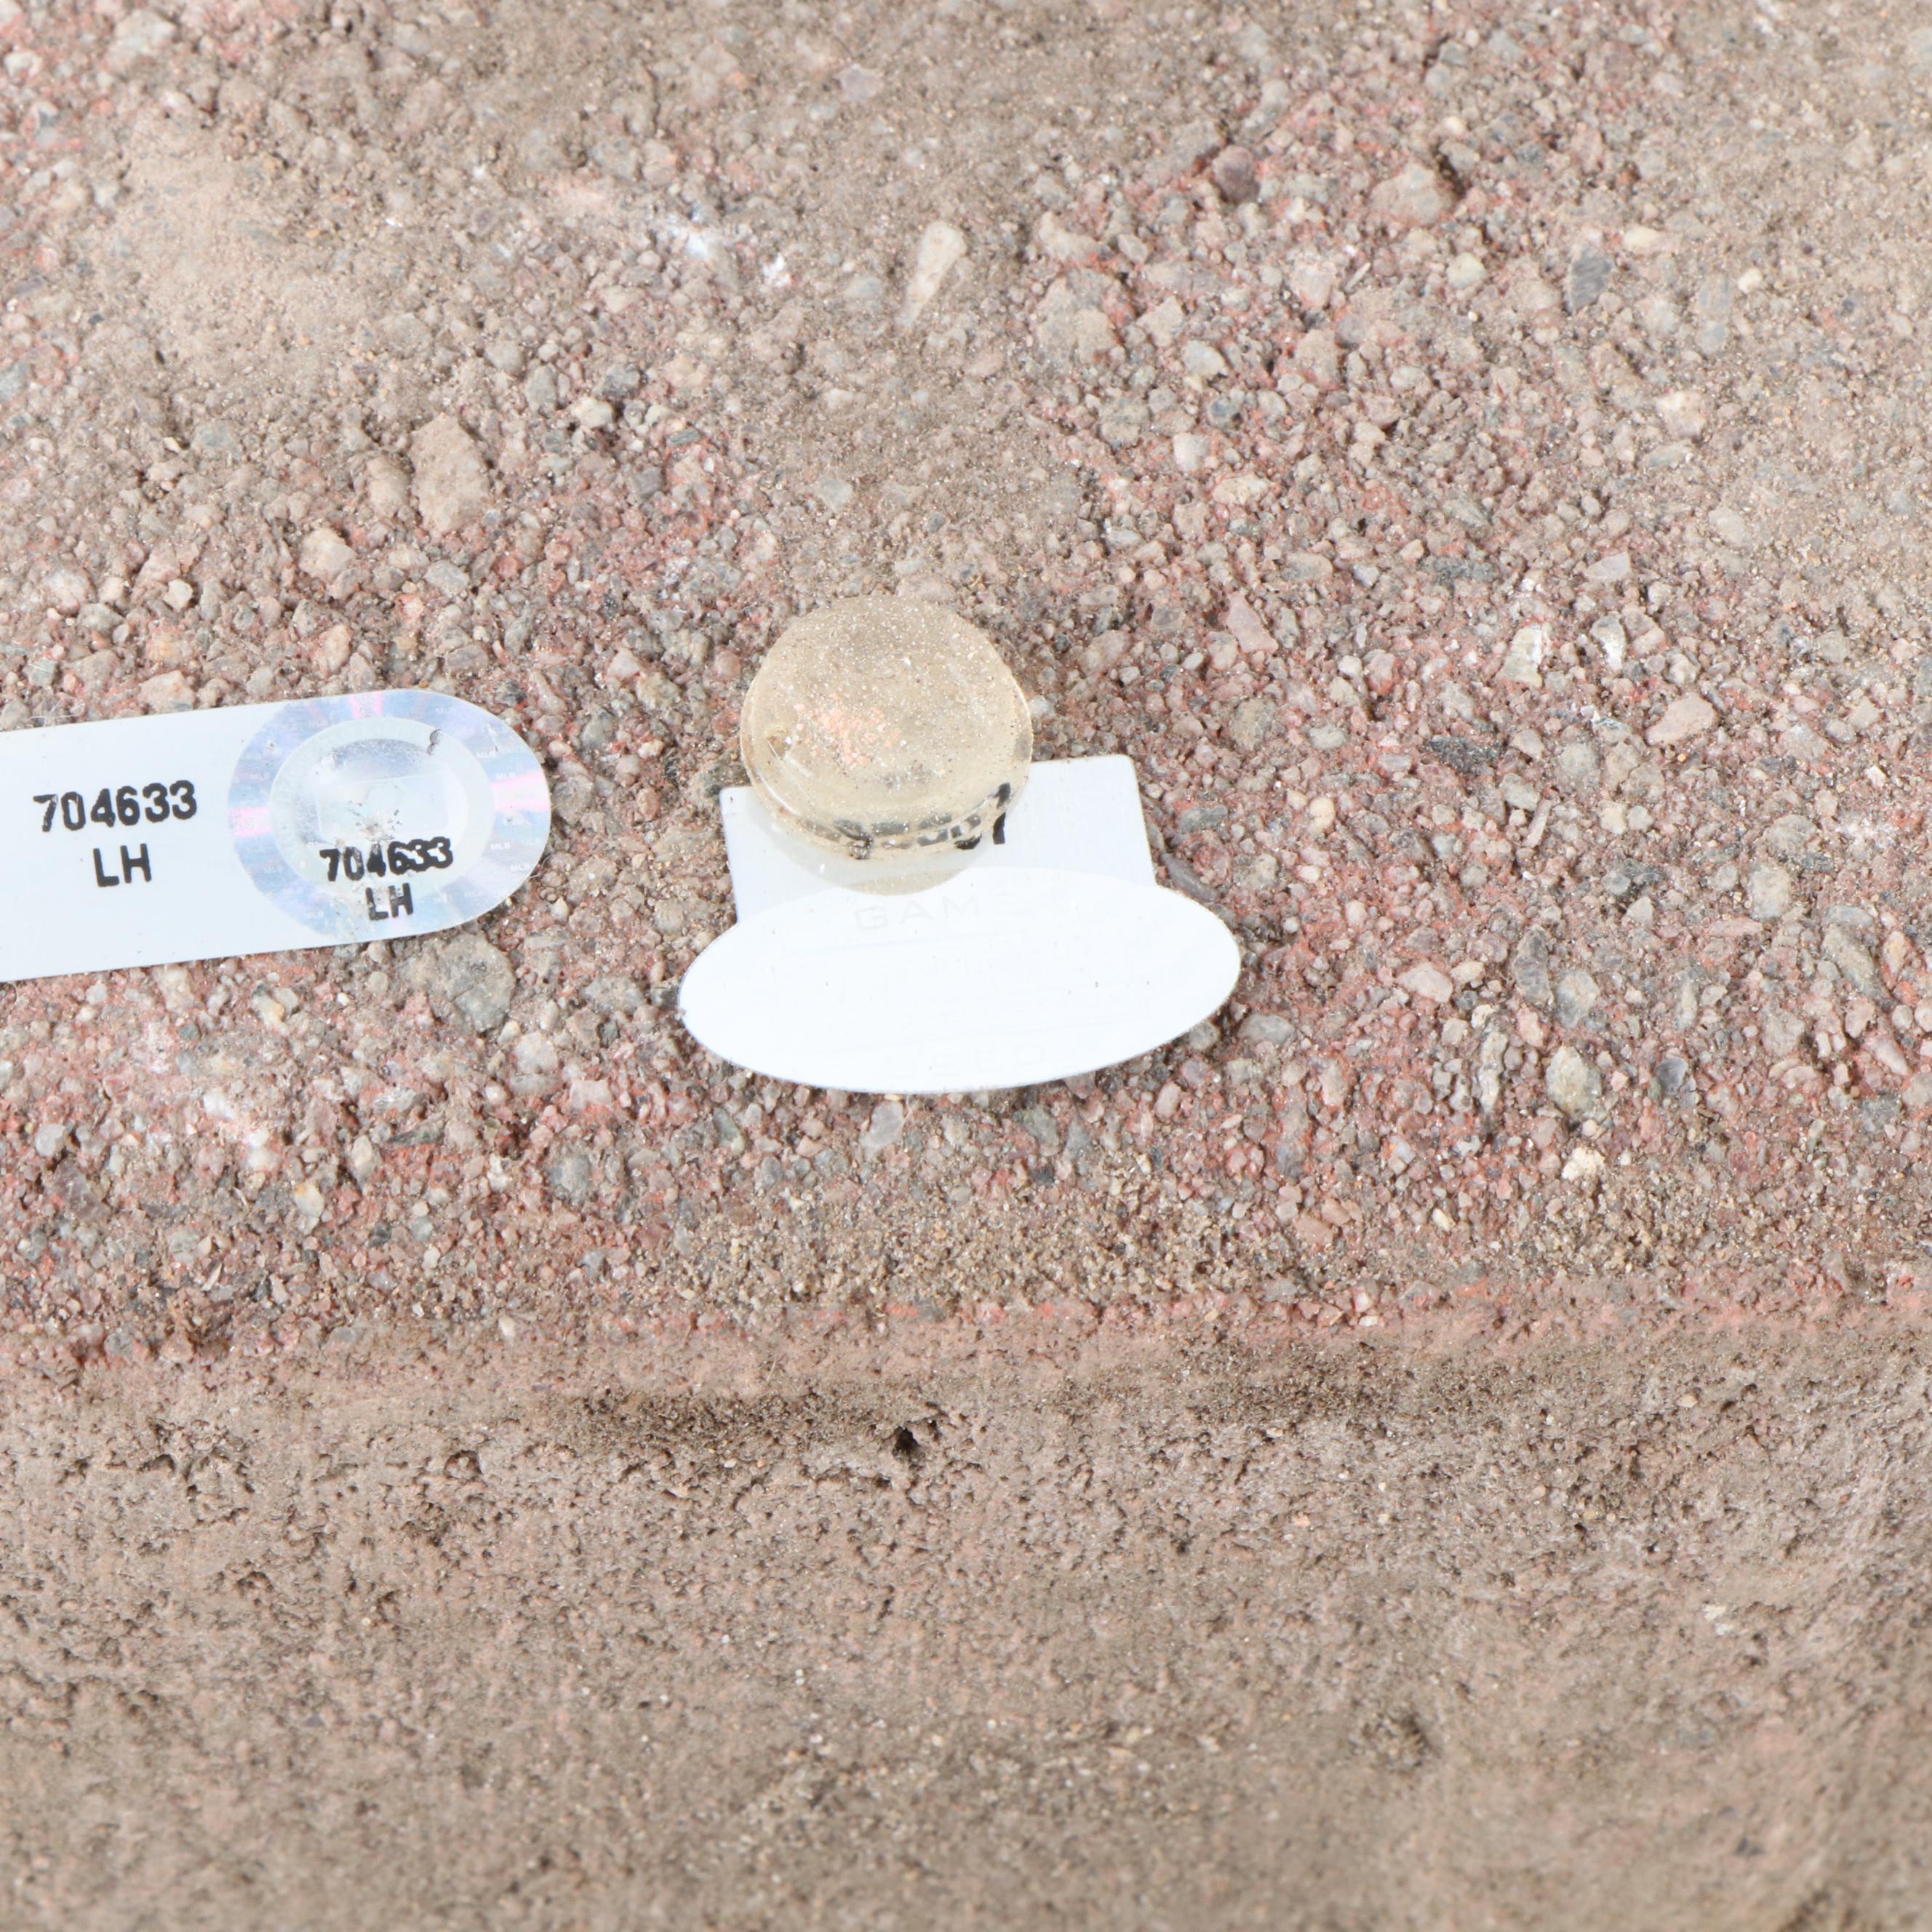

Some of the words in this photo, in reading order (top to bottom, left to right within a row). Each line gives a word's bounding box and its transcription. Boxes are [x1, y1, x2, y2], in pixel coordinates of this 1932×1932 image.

[33, 780, 197, 832] 704633
[92, 843, 152, 888] LH
[319, 836, 454, 882] 704633
[365, 882, 415, 922] LH
